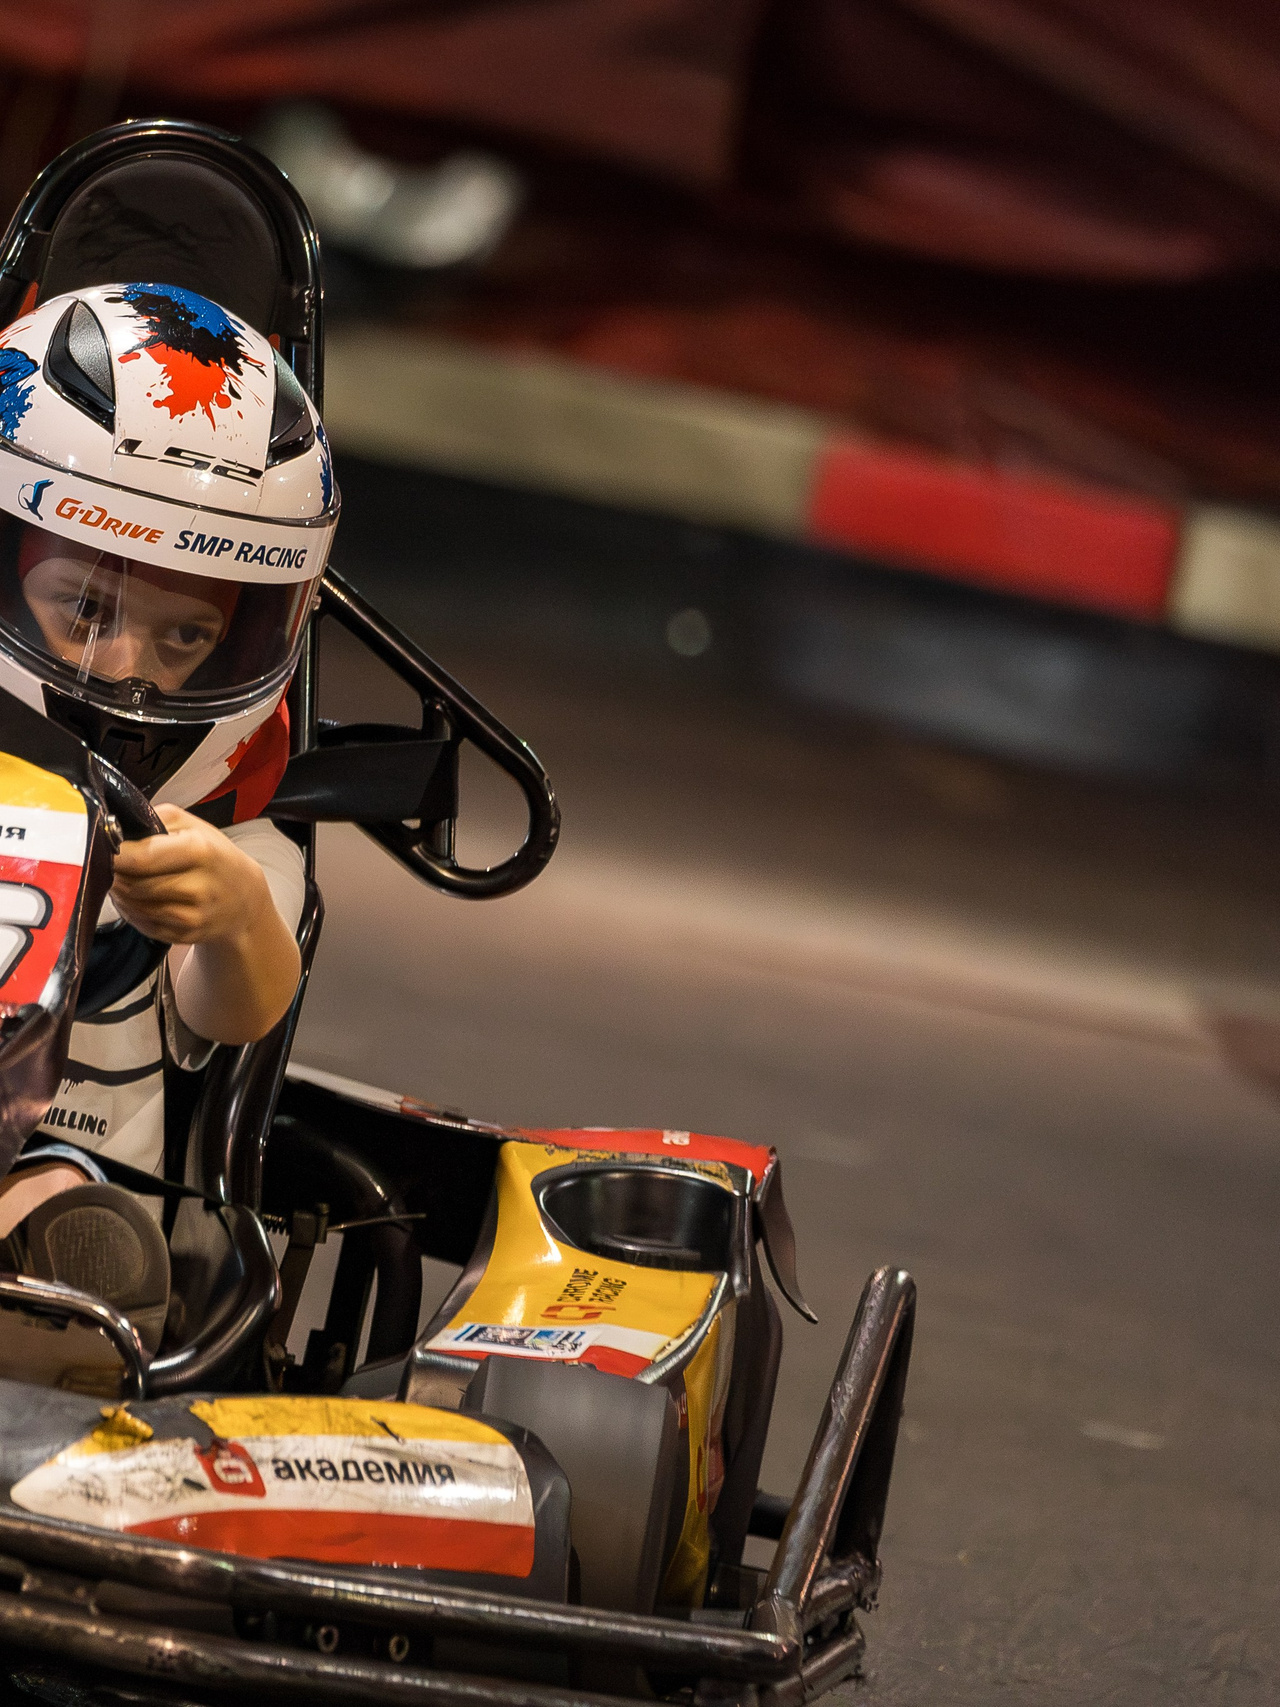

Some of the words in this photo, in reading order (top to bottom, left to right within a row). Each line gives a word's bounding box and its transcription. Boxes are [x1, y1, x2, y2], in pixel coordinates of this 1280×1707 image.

[115, 438, 263, 487] LS2
[174, 530, 234, 567] SMP
[234, 541, 308, 569] RACING
[272, 1457, 457, 1486] академия
